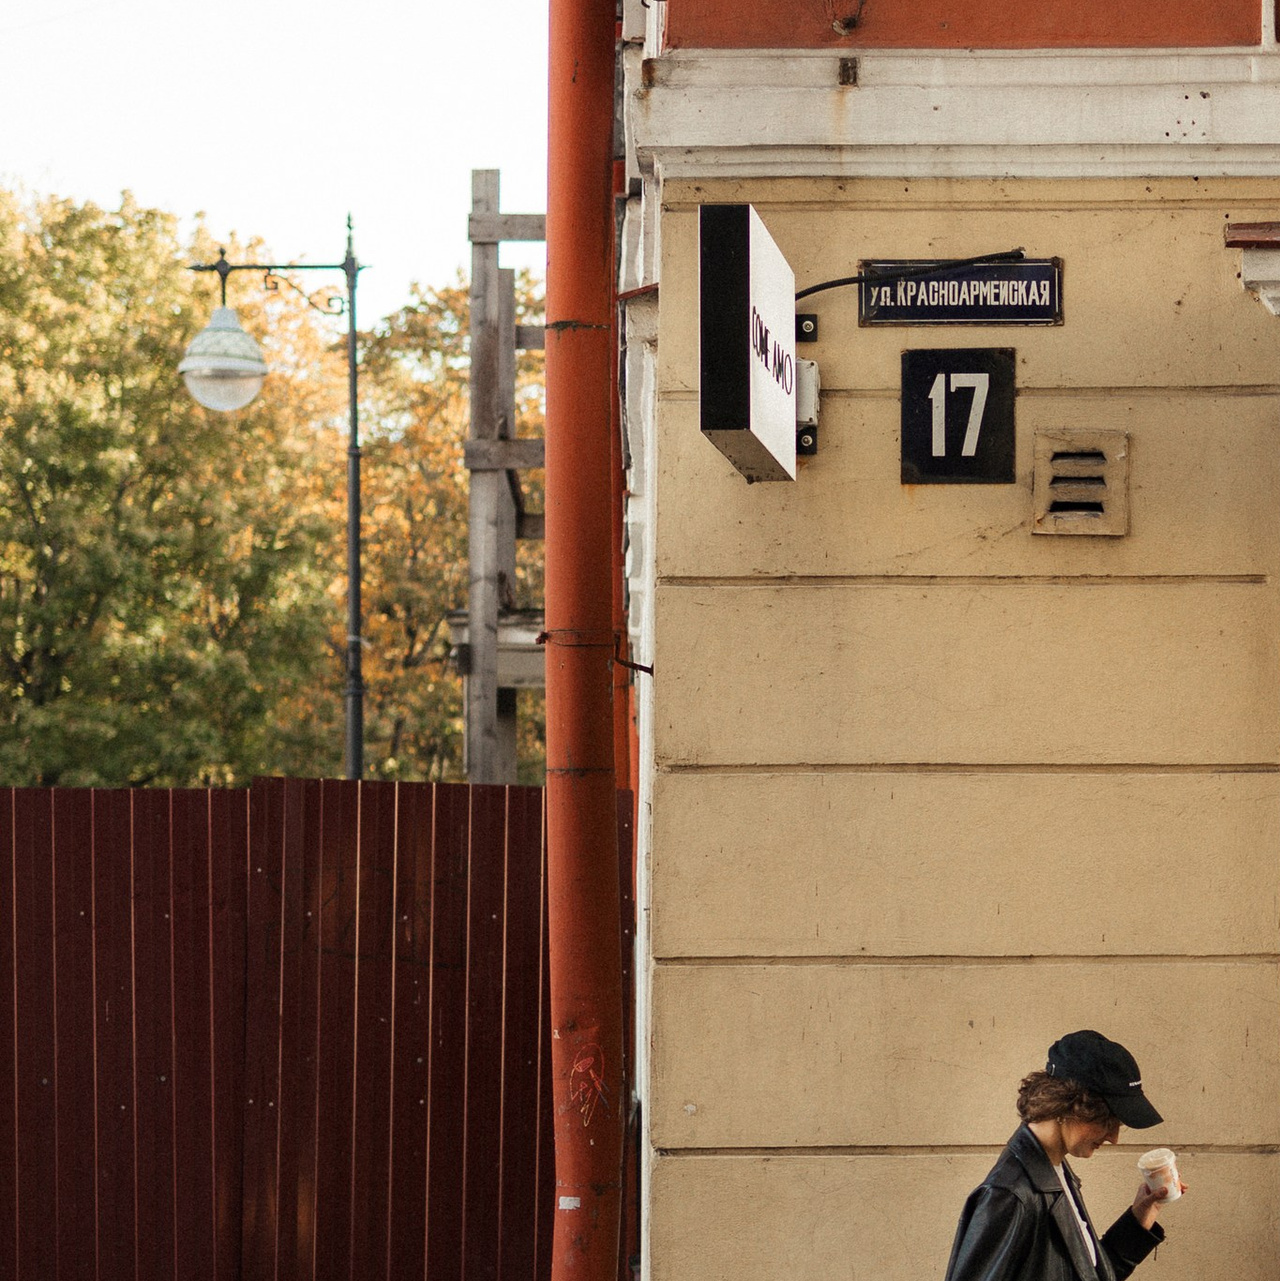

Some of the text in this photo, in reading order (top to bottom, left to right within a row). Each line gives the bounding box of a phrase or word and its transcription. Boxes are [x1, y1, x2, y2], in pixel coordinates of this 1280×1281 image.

[897, 280, 1050, 306] КРАСНОАРМЕЙСКАЯ
[772, 340, 793, 395] AMO
[927, 373, 989, 457] 17
